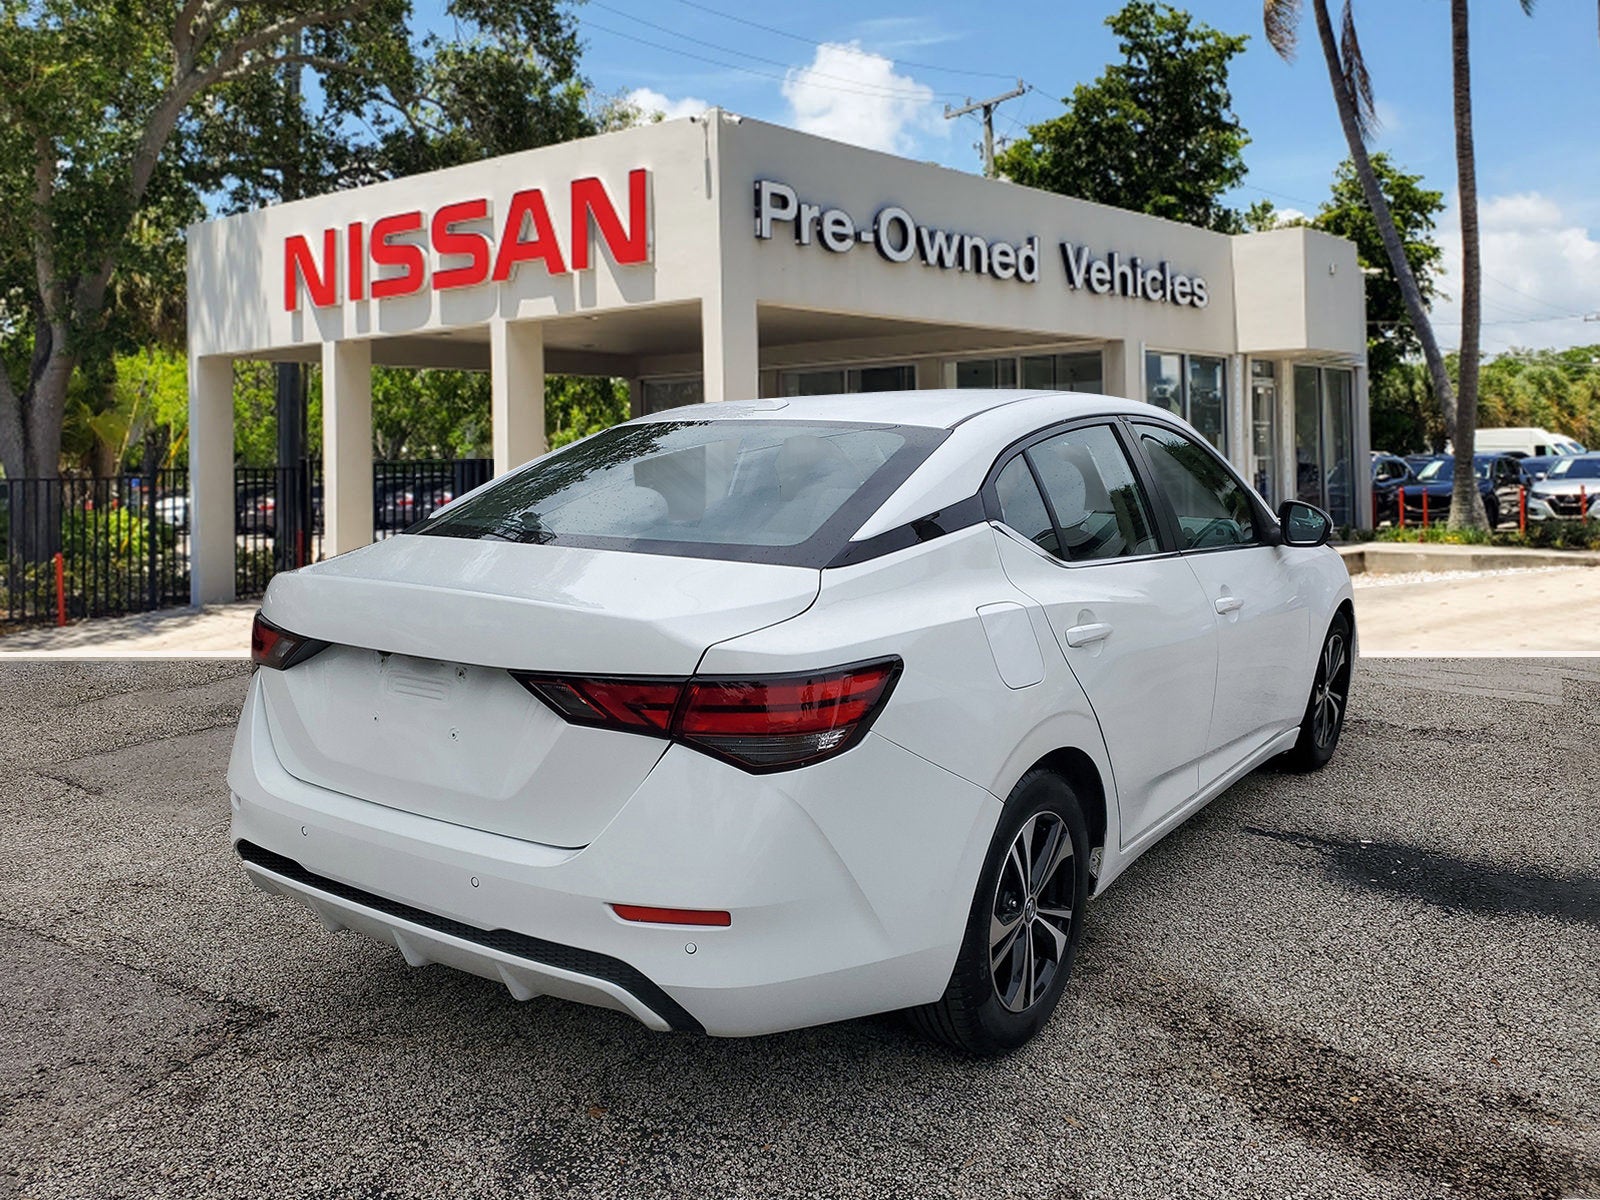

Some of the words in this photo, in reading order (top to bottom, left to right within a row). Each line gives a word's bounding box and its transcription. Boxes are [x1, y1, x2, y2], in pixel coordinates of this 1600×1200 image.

[284, 168, 649, 312] NISSAN
[755, 180, 1040, 283] Pre-Owned
[1061, 241, 1209, 308] Vehicles
